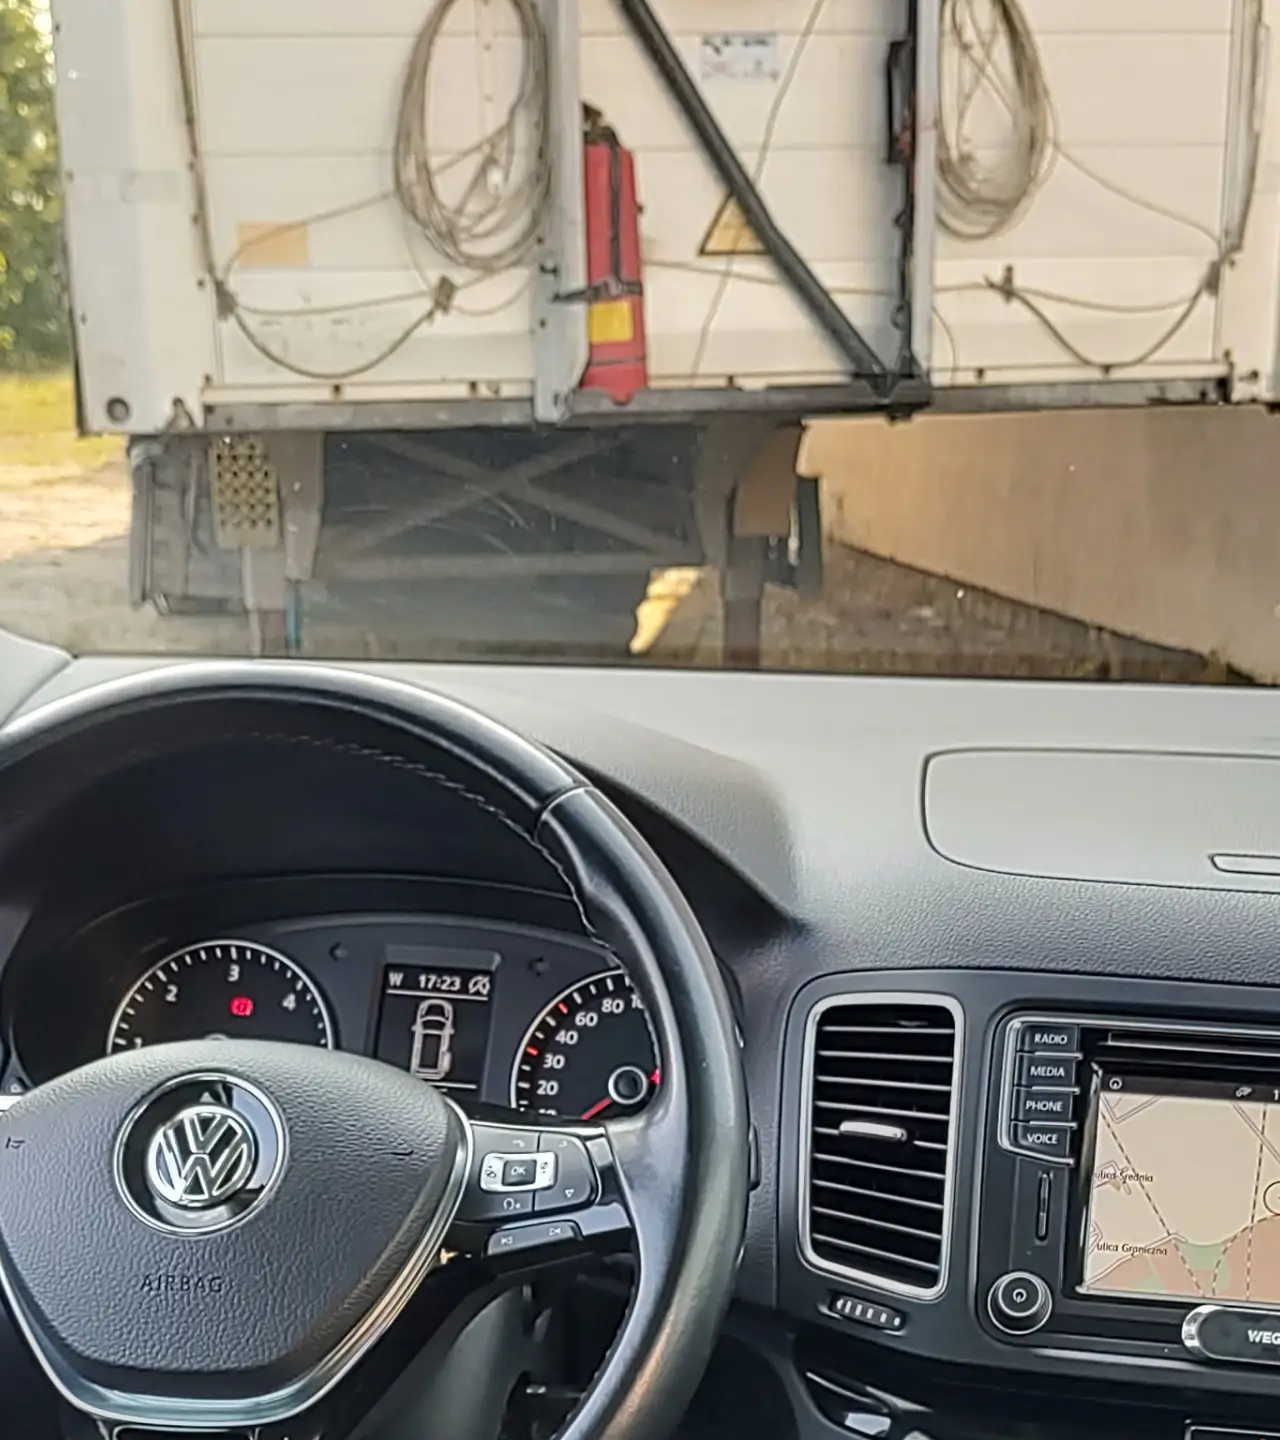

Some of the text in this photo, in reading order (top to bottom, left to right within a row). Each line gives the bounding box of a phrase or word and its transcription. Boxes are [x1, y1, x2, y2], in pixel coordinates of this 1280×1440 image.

[228, 964, 240, 982] 3
[388, 972, 461, 991] W 17:23
[165, 985, 178, 1002] 2
[282, 993, 296, 1011] 4
[601, 998, 624, 1014] 80
[574, 1012, 598, 1027] 60
[555, 1030, 579, 1045] 40
[1034, 1033, 1068, 1045] RADIO
[543, 1054, 565, 1069] 30
[1030, 1065, 1065, 1077] MEDIA
[536, 1080, 559, 1095] 20
[1025, 1100, 1063, 1112] PHONE
[1026, 1133, 1058, 1145] VOICE
[511, 1166, 527, 1175] OK
[1097, 1242, 1118, 1251] ulica
[140, 1274, 222, 1293] AIRBAG
